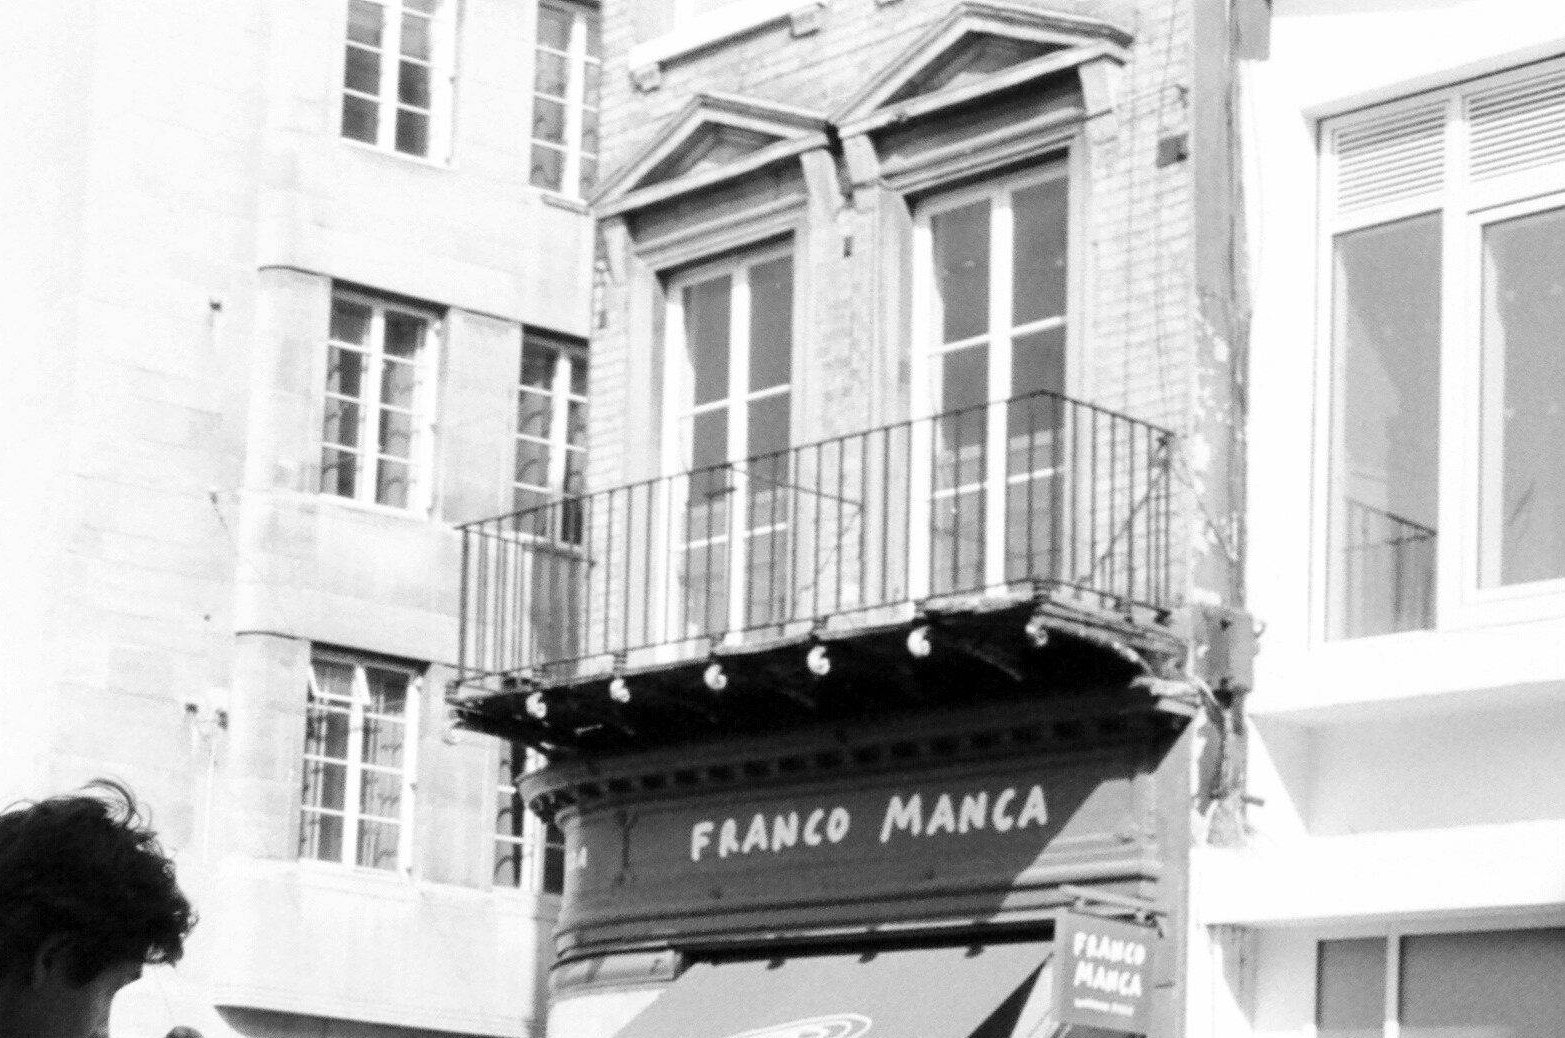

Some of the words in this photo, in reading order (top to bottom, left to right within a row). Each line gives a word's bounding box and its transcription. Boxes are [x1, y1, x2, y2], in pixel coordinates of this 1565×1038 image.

[690, 806, 851, 862] FRANCO
[879, 784, 1048, 844] MANCA
[1073, 931, 1146, 967] FRANCO
[1073, 959, 1142, 998] MANCA
